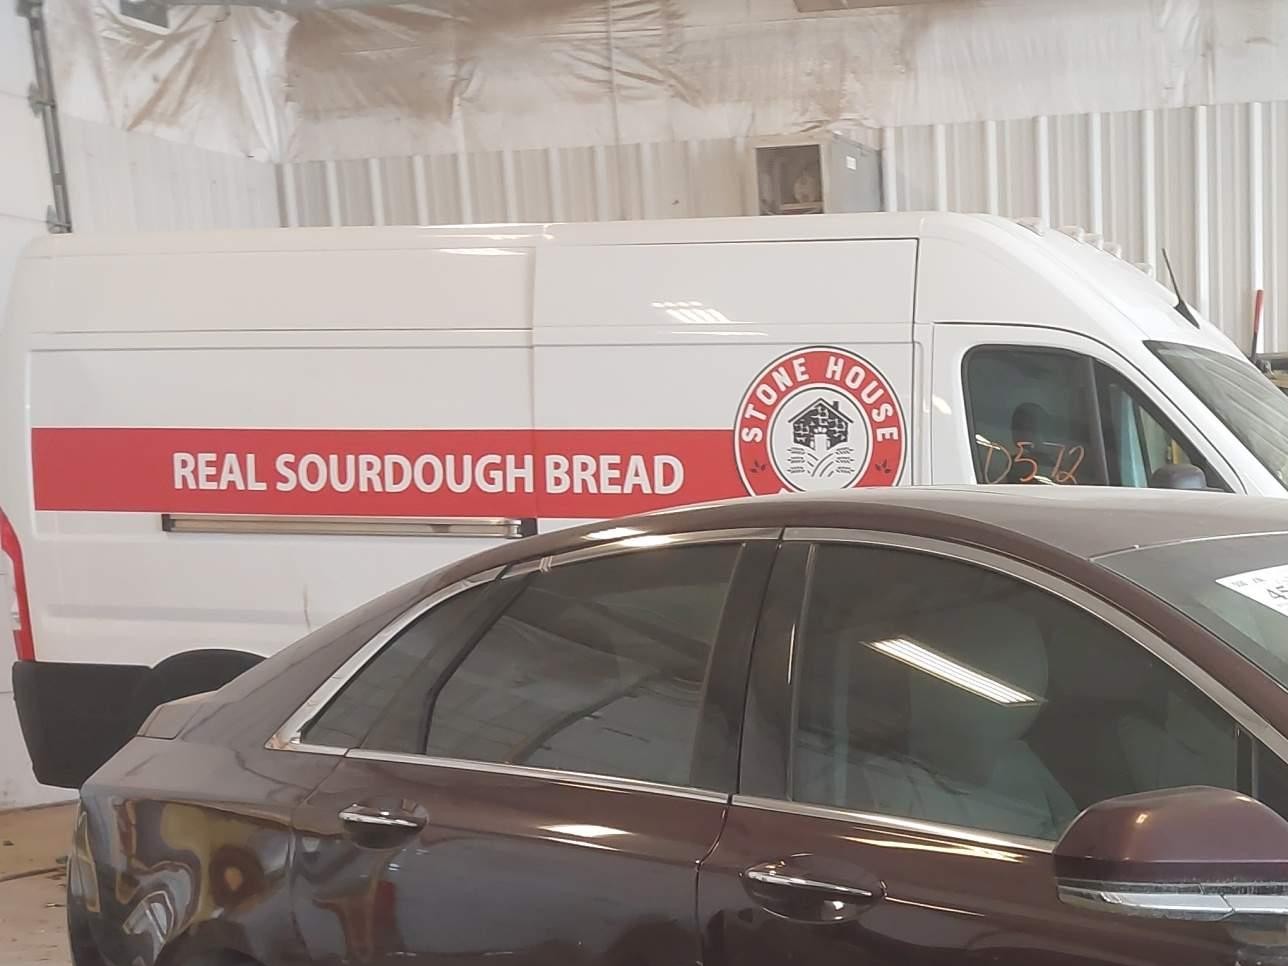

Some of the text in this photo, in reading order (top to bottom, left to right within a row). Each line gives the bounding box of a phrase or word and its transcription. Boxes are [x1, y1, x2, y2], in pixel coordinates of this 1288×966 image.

[741, 355, 899, 443] STONE HOUSE
[173, 452, 685, 495] REAL SOURDOUGH BREAD
